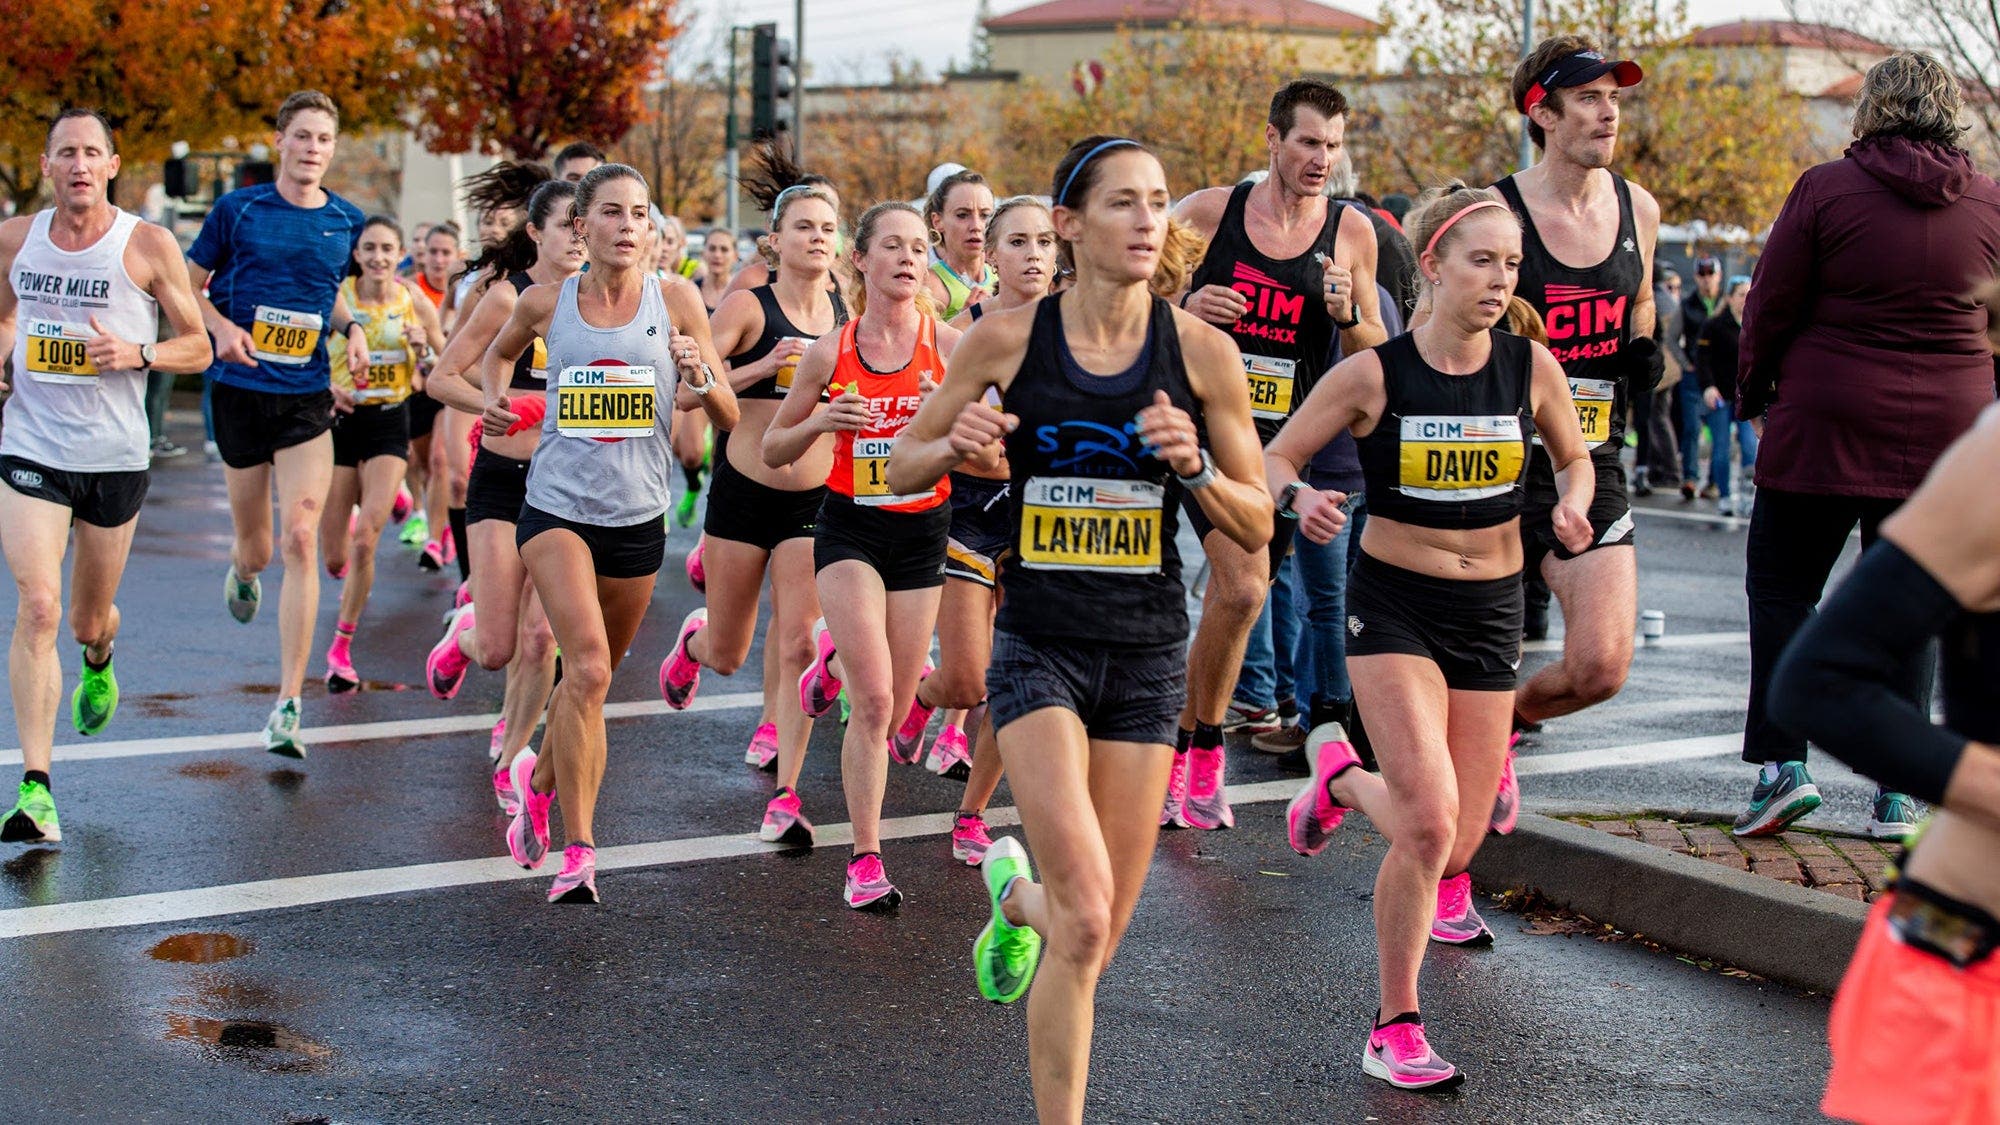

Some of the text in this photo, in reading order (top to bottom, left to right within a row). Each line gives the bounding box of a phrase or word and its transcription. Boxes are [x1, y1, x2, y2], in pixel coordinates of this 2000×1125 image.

[19, 271, 110, 299] POWER MILER
[39, 294, 80, 308] TRACK CLUB
[1230, 281, 1305, 325] CIM
[36, 322, 63, 337] CIM
[266, 311, 291, 325] CIM
[1545, 295, 1628, 340] CIM
[263, 324, 308, 350] 7808
[1232, 319, 1297, 345] 2:44:XX
[37, 339, 87, 367] 1009
[1551, 337, 1620, 363] 2:44:XX
[573, 370, 605, 385] CIM
[559, 392, 653, 420] ELLENDER
[895, 396, 920, 411] FE
[1423, 422, 1462, 438] CIM
[1575, 405, 1599, 435] ER
[1425, 449, 1500, 482] DAVIS
[1050, 484, 1095, 504] CIM
[1032, 514, 1152, 556] LAYMAN
